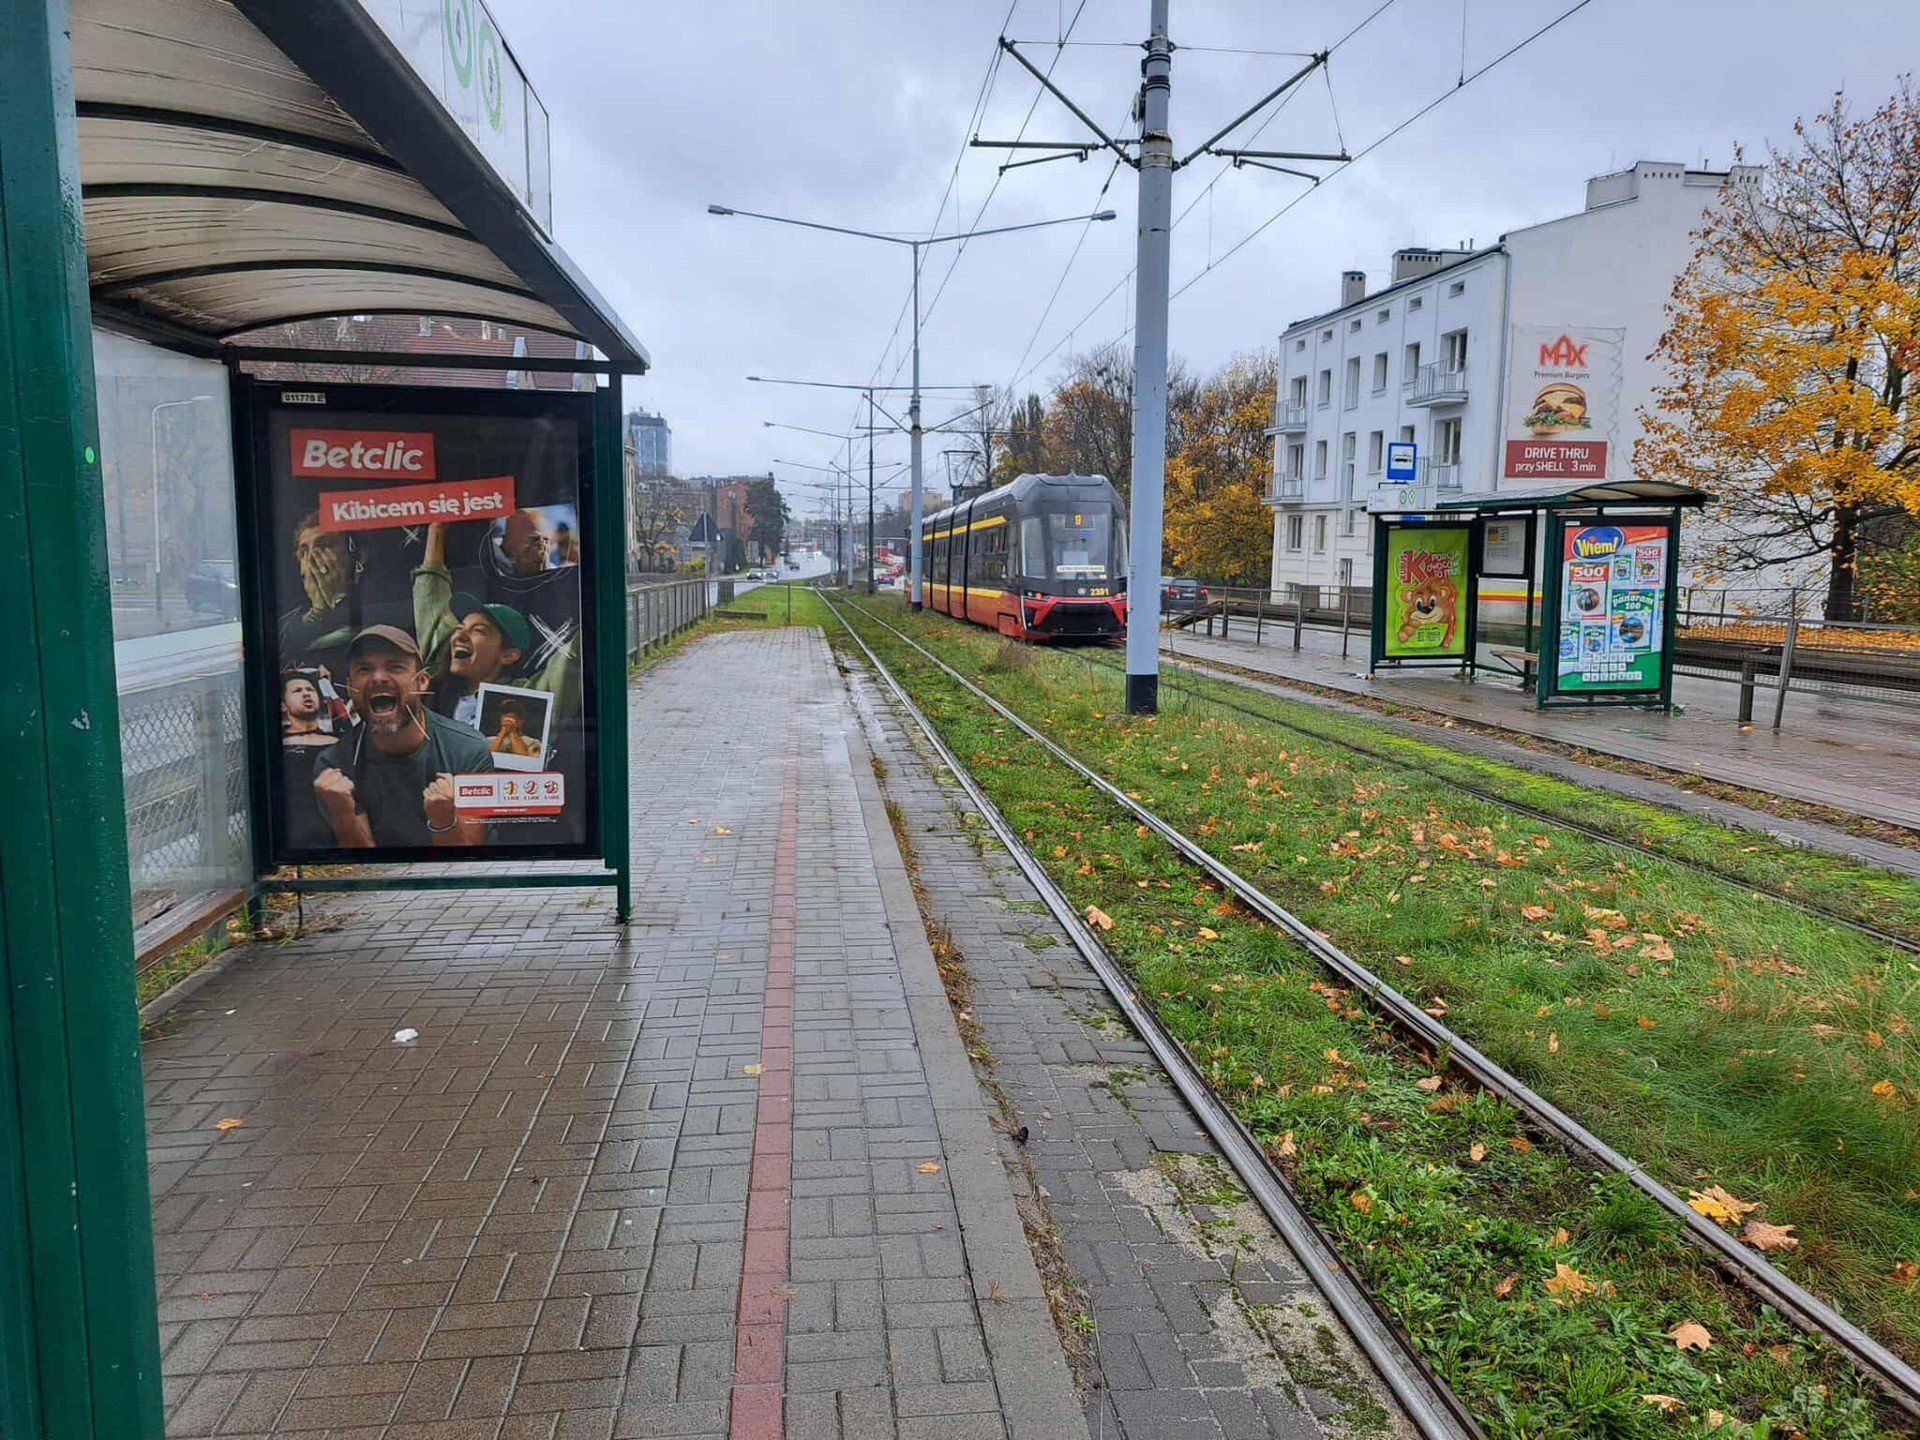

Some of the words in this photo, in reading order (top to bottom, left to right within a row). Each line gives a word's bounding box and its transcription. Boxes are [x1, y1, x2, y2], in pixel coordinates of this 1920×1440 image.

[302, 439, 424, 471] Betclic
[1525, 447, 1558, 459] DRIVE
[1559, 447, 1589, 459] THRU
[1515, 463, 1535, 473] przy
[1535, 461, 1564, 472] SHELL
[1572, 461, 1580, 472] 3
[1580, 462, 1596, 472] min
[332, 498, 425, 522] Kibicem
[427, 493, 460, 515] się
[462, 491, 503, 516] jest
[1576, 536, 1619, 557] Wiem!
[1573, 566, 1605, 577] 500
